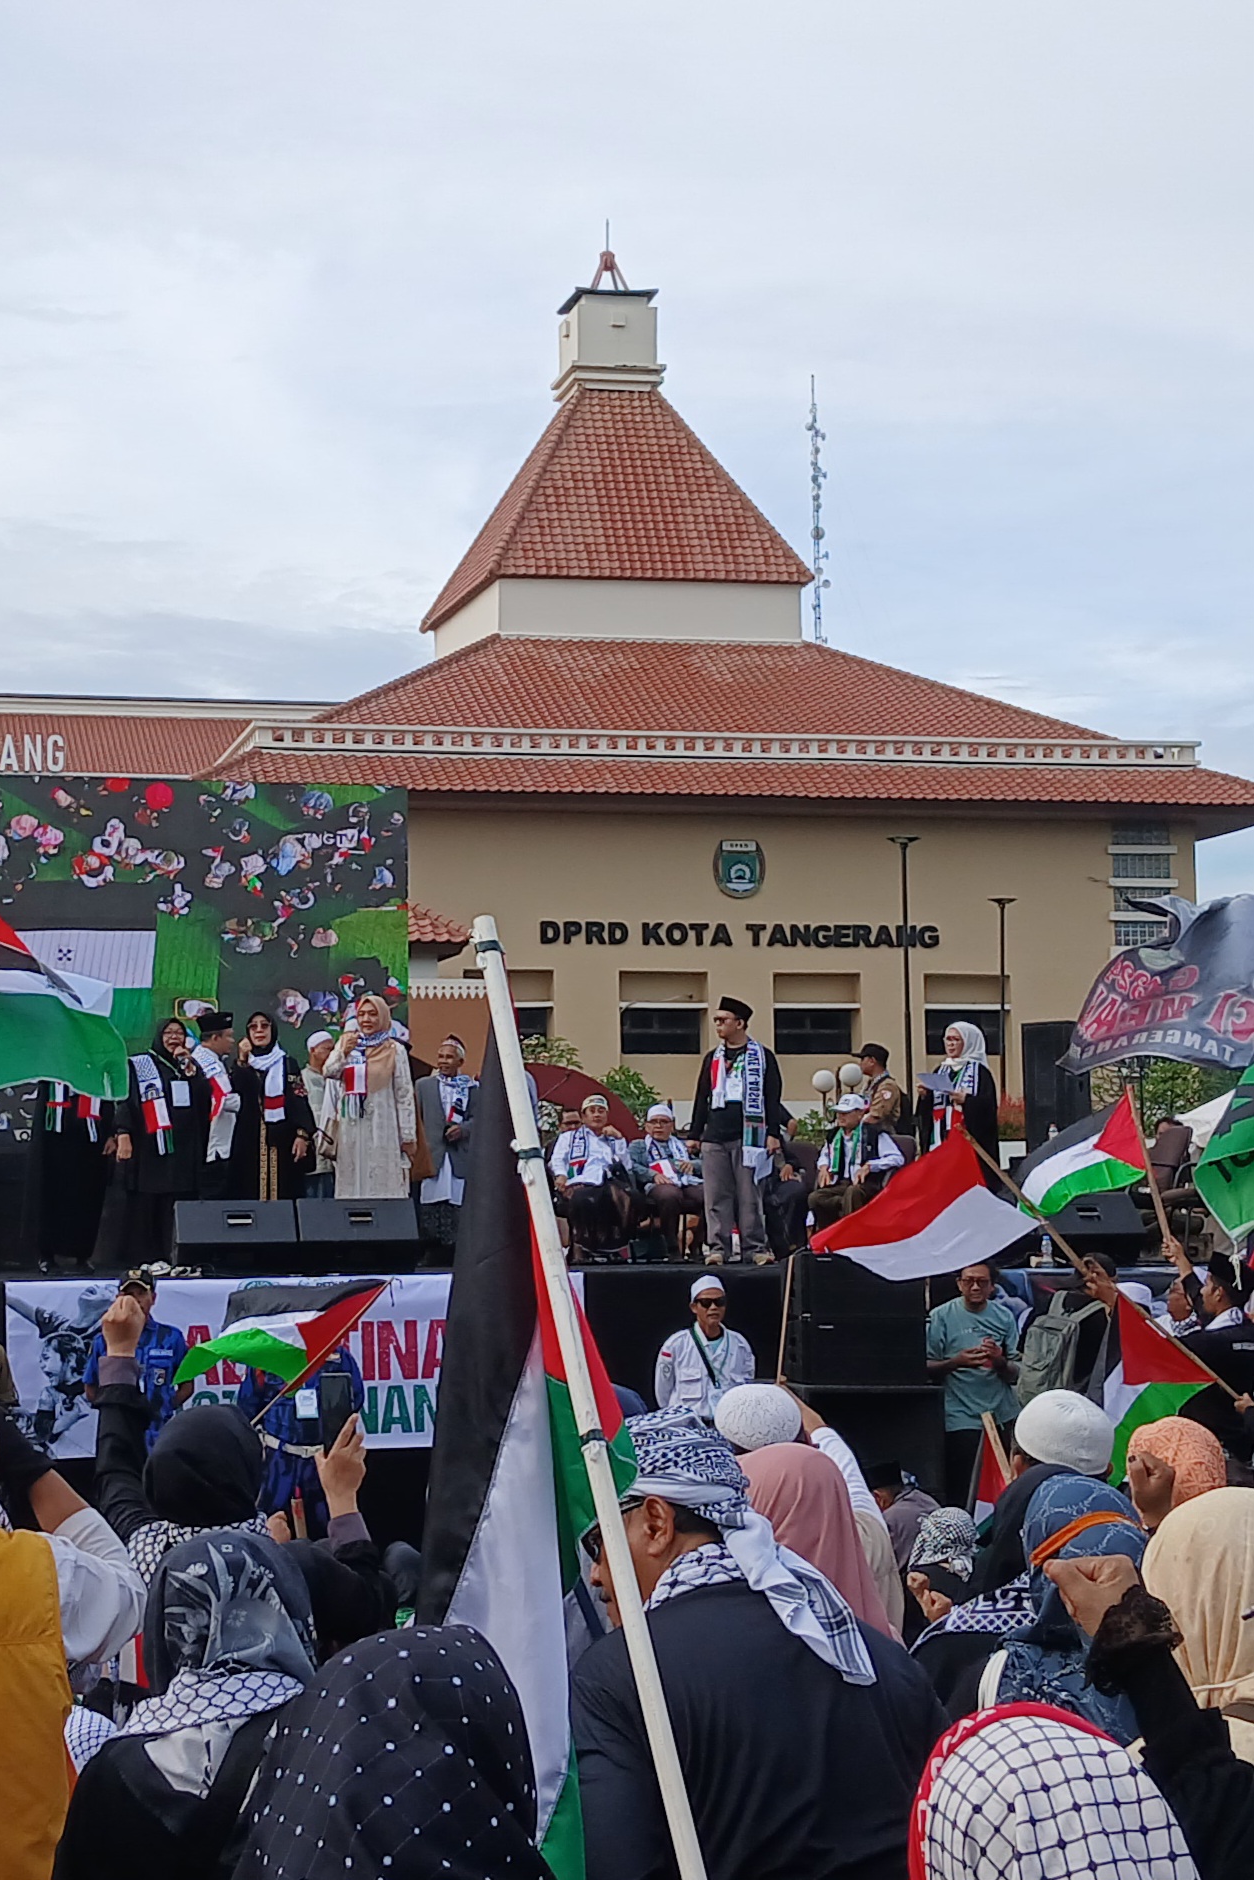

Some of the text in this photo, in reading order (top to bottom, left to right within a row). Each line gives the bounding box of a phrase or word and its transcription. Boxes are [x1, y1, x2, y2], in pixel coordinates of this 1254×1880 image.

[539, 920, 940, 949] DPRD KOTA TANGERANG
